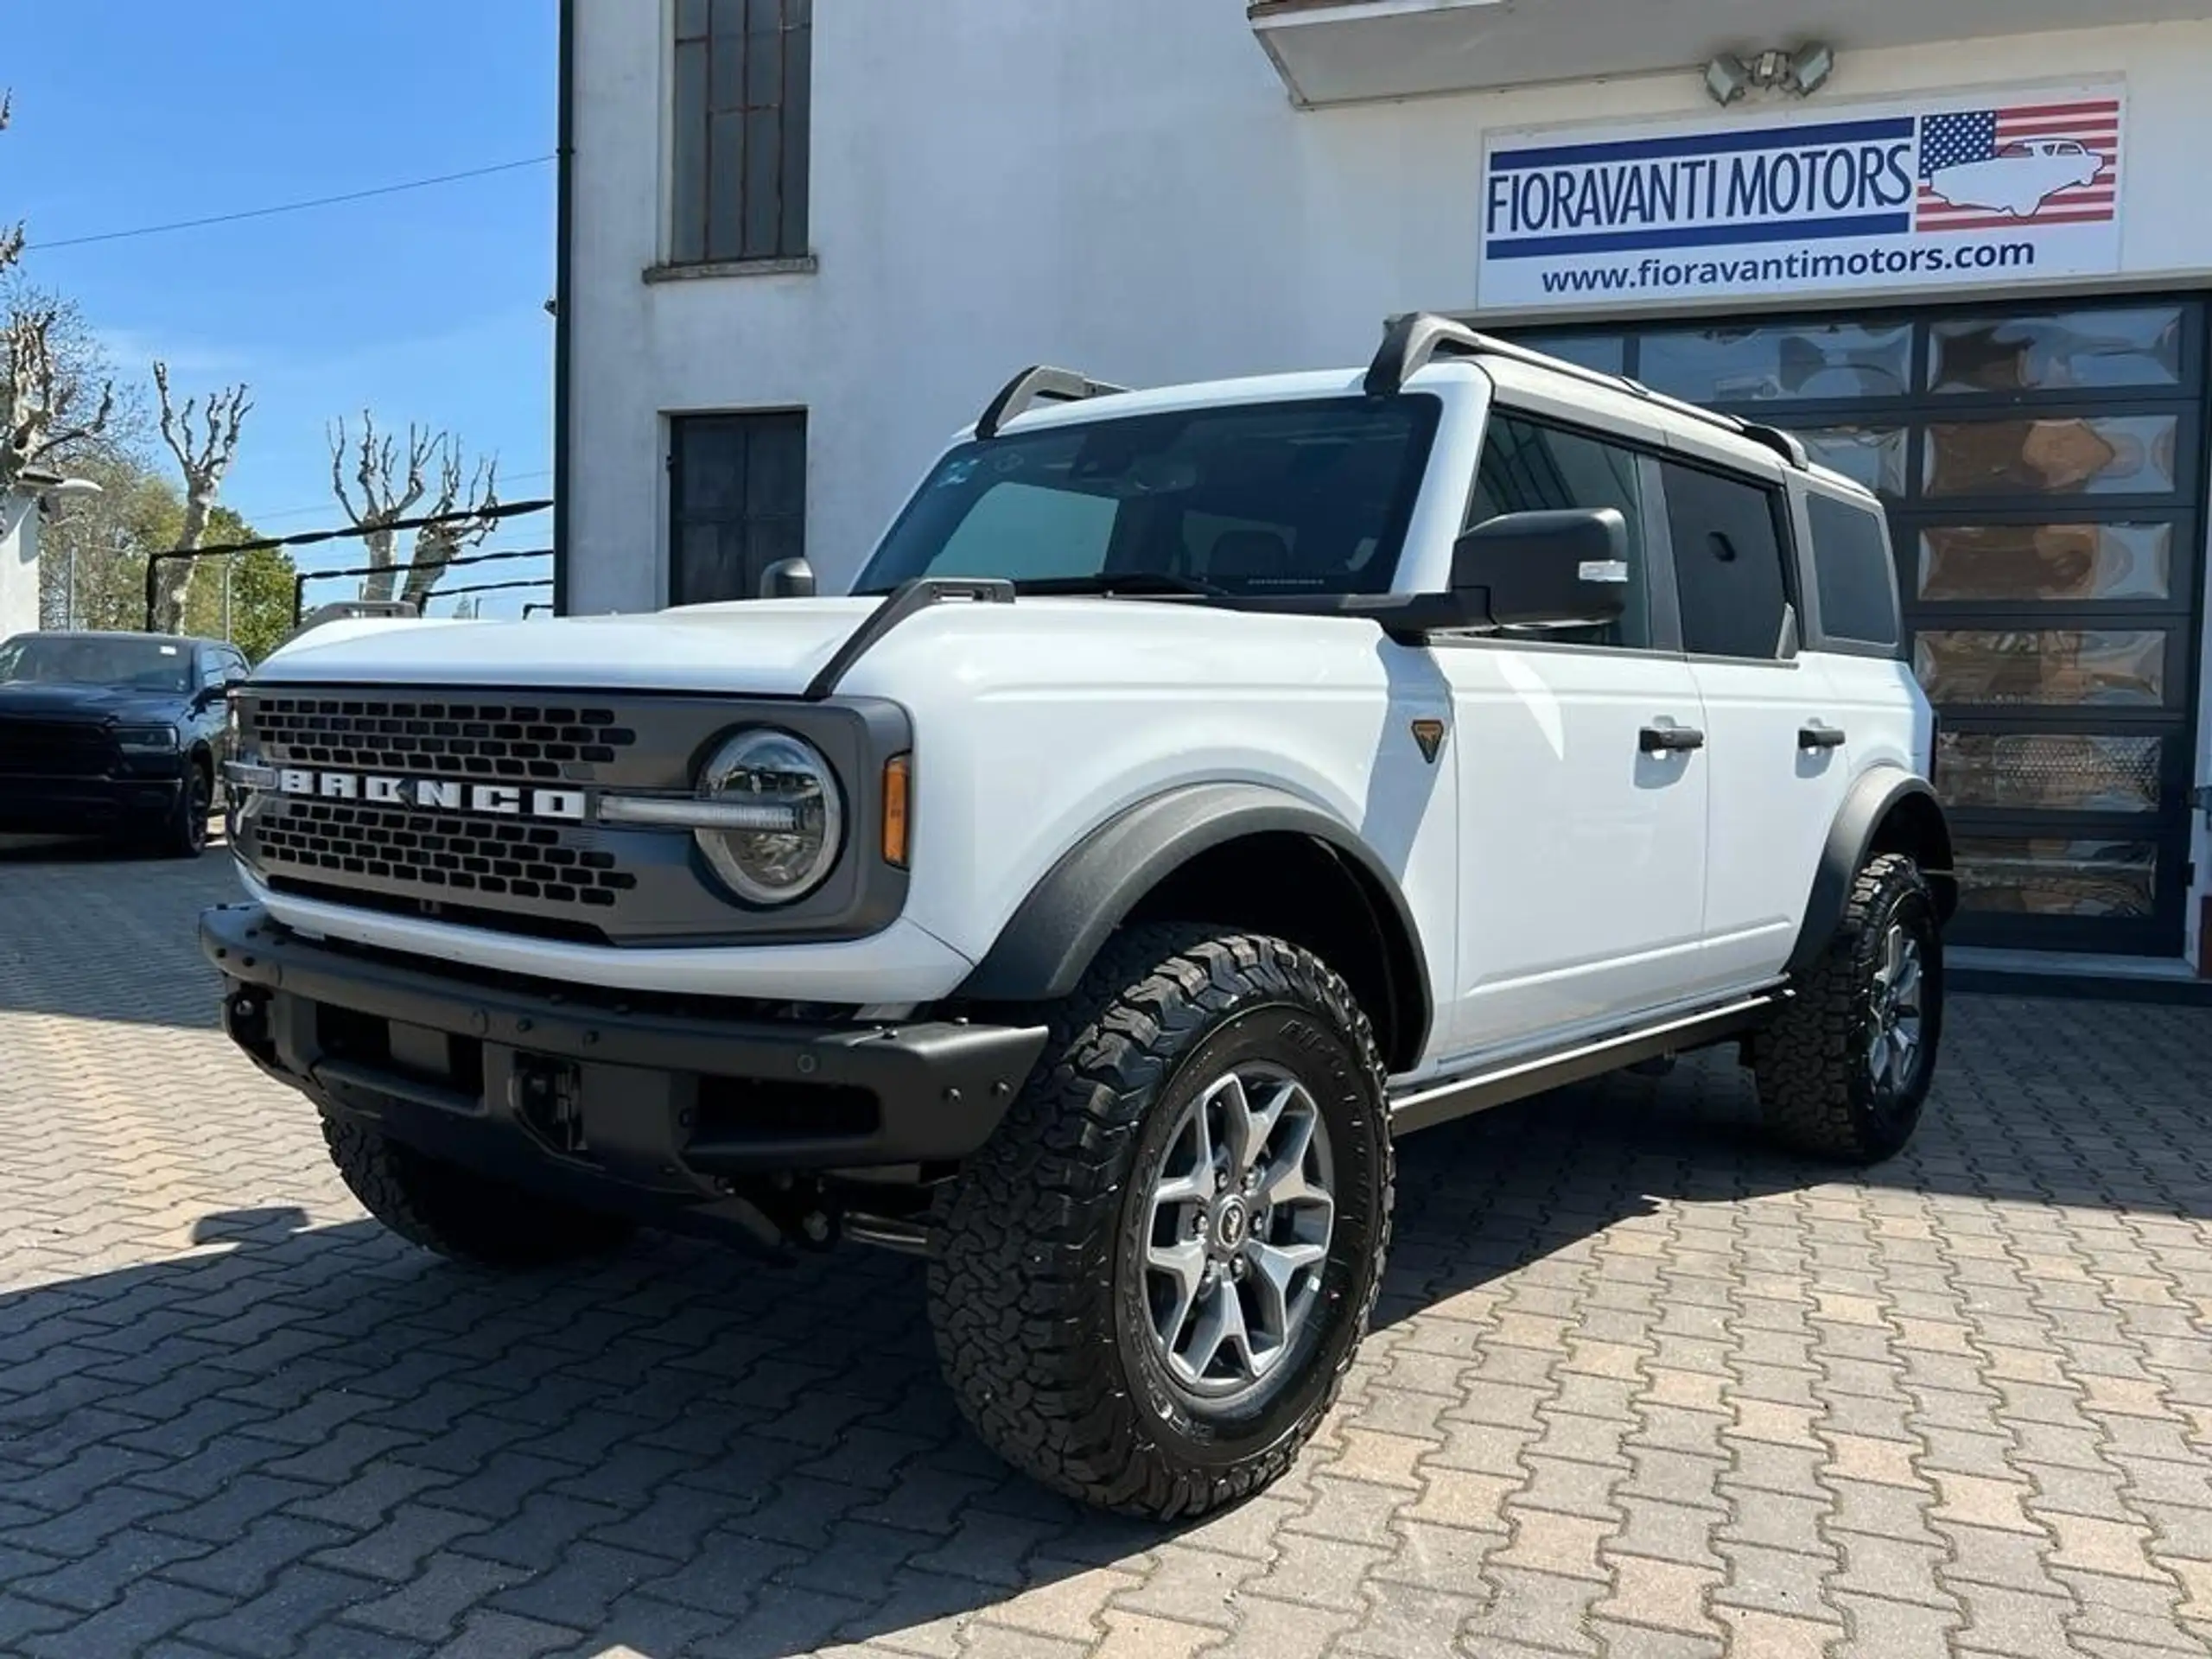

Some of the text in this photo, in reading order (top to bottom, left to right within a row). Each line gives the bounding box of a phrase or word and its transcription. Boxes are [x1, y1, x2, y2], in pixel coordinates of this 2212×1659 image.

[1486, 143, 1912, 234] FIORAVANTI MOTORS
[1541, 242, 2035, 293] www.fioravantimotors.com
[281, 768, 585, 818] BRONCO
